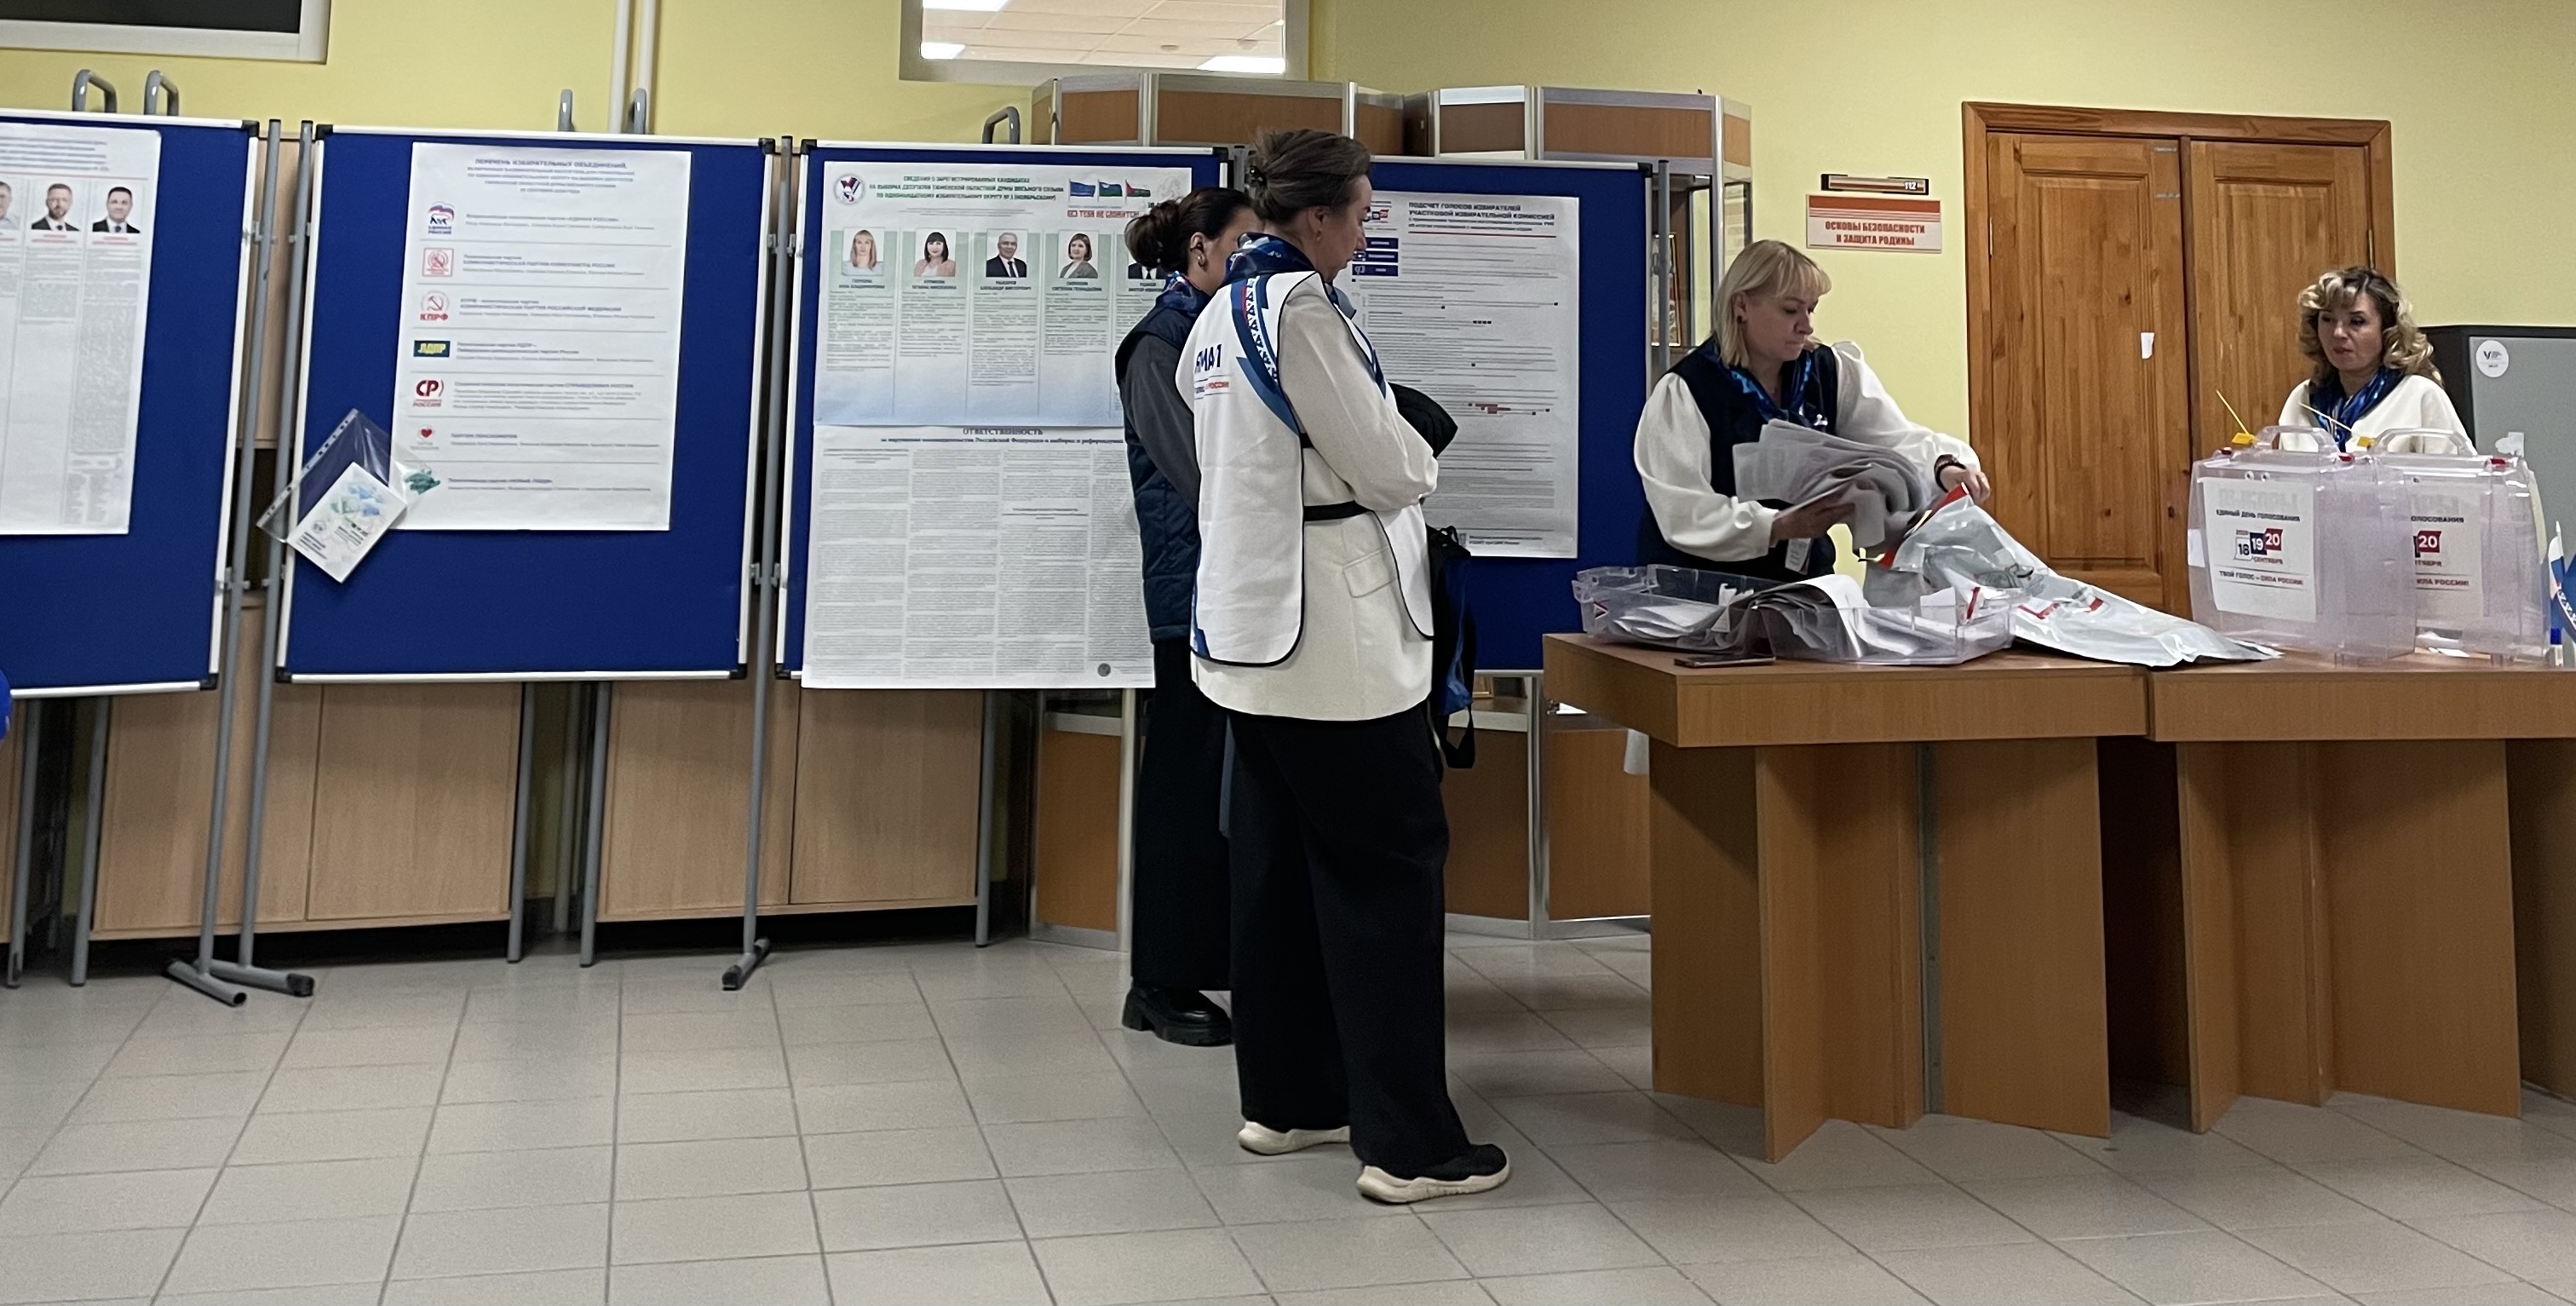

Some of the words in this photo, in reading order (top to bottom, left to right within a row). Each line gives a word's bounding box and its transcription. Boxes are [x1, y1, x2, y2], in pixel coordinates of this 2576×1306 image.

[1904, 181, 1917, 190] 112
[1826, 222, 1860, 231] ОСНОВЫ
[1863, 223, 1924, 233] БЕЗОПАСНОСТИ
[1837, 234, 1842, 243] И
[1843, 234, 1877, 245] ЗАЩИТА
[1878, 236, 1915, 245] РОДИНЫ
[2257, 512, 2301, 521] ГОЛОСОВАНИЯ
[2238, 544, 2250, 555] 18
[2251, 538, 2263, 551] 19
[2266, 533, 2280, 546] 20
[2418, 535, 2438, 549] 20
